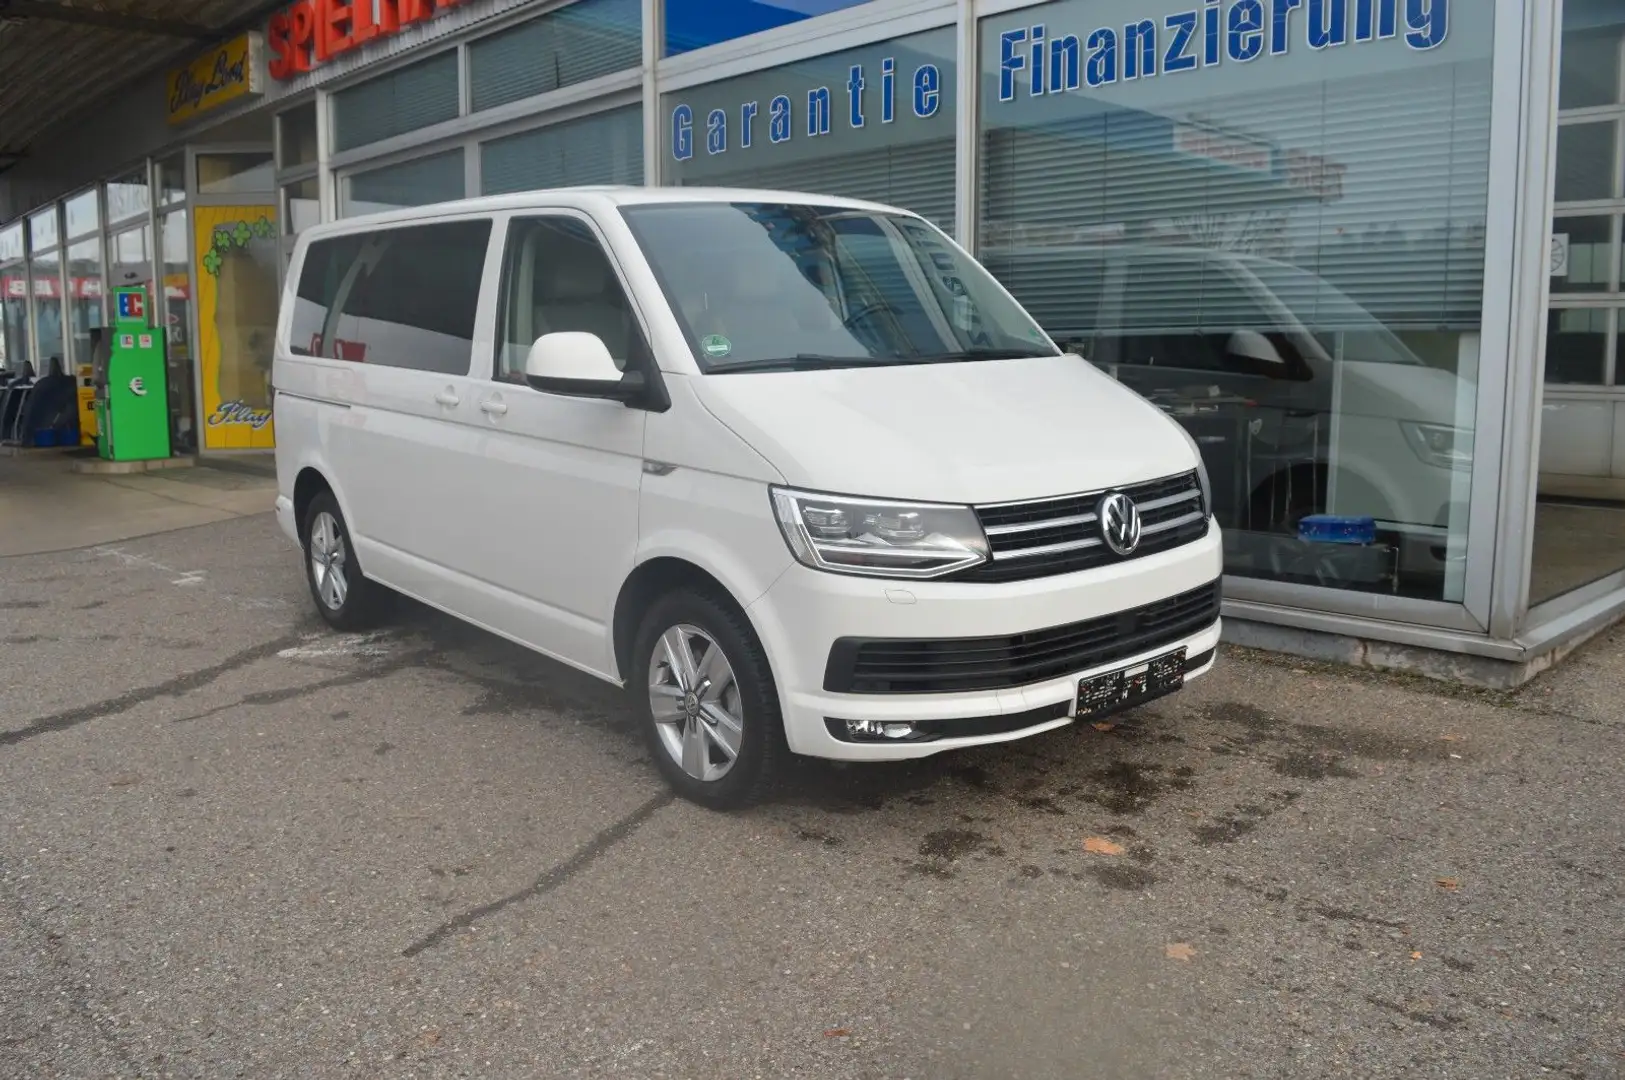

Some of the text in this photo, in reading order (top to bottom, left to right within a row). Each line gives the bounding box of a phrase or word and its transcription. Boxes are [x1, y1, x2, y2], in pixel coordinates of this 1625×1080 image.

[999, 0, 1448, 101] Finanzierung
[672, 57, 940, 161] Garantie
[208, 399, 272, 430] Play
